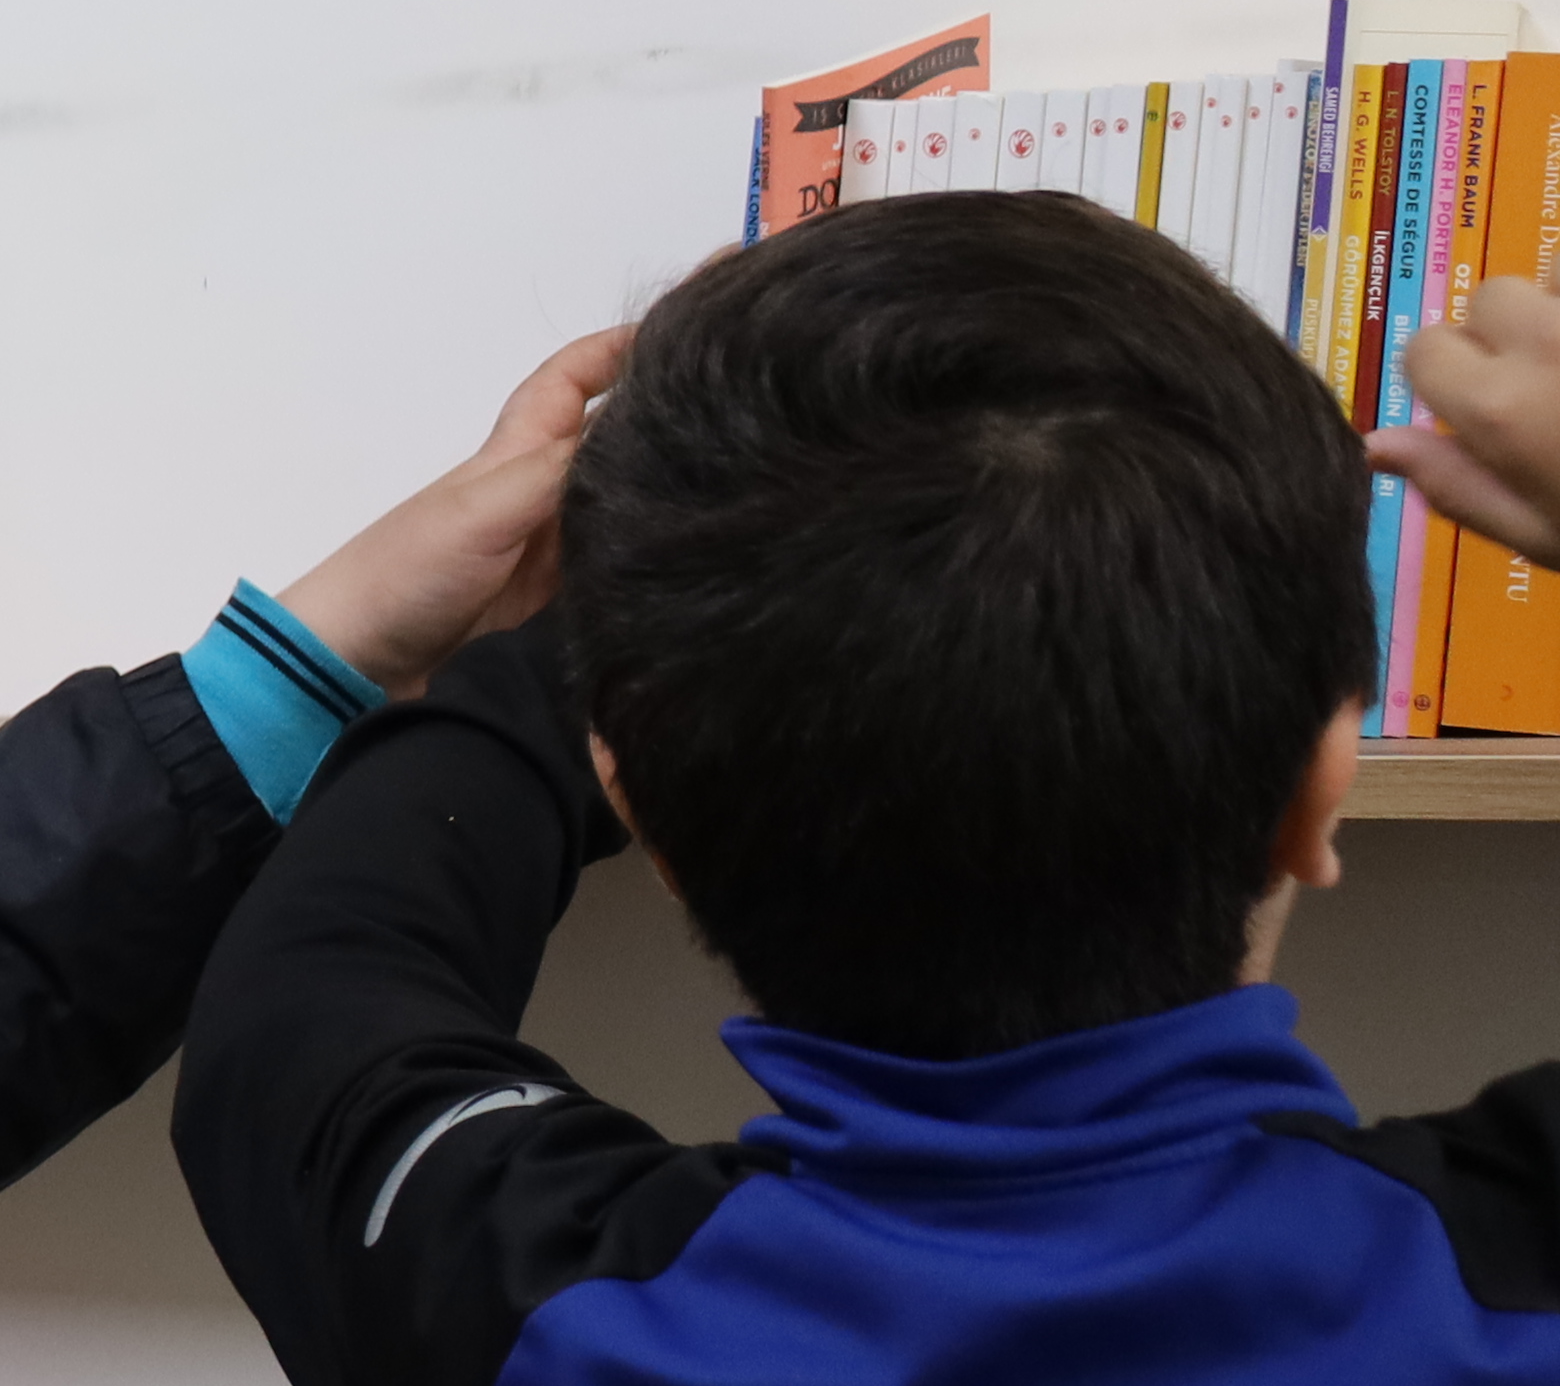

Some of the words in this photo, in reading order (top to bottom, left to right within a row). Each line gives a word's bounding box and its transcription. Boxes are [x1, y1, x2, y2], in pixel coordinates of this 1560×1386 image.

[1322, 86, 1339, 121] SAMED
[1357, 90, 1371, 108] H.
[1471, 84, 1487, 100] L.
[1356, 114, 1369, 132] G.
[1407, 84, 1429, 183] COMTESSE
[1441, 83, 1462, 172] ELEANOR
[1466, 106, 1485, 169] FRANK
[1350, 138, 1368, 201] WELLS
[1380, 127, 1397, 196] TOLSTOY
[1439, 177, 1454, 195] H.
[1404, 188, 1420, 213] DE
[1460, 175, 1479, 229] BAUM
[1399, 218, 1420, 280] SÉGUR
[1431, 201, 1452, 275] PORTER
[1336, 234, 1362, 340] GÖRÜNMEZ
[1366, 229, 1391, 322] İLKGENÇLİK
[1453, 262, 1471, 291] OZ
[1392, 314, 1412, 346] BİR
